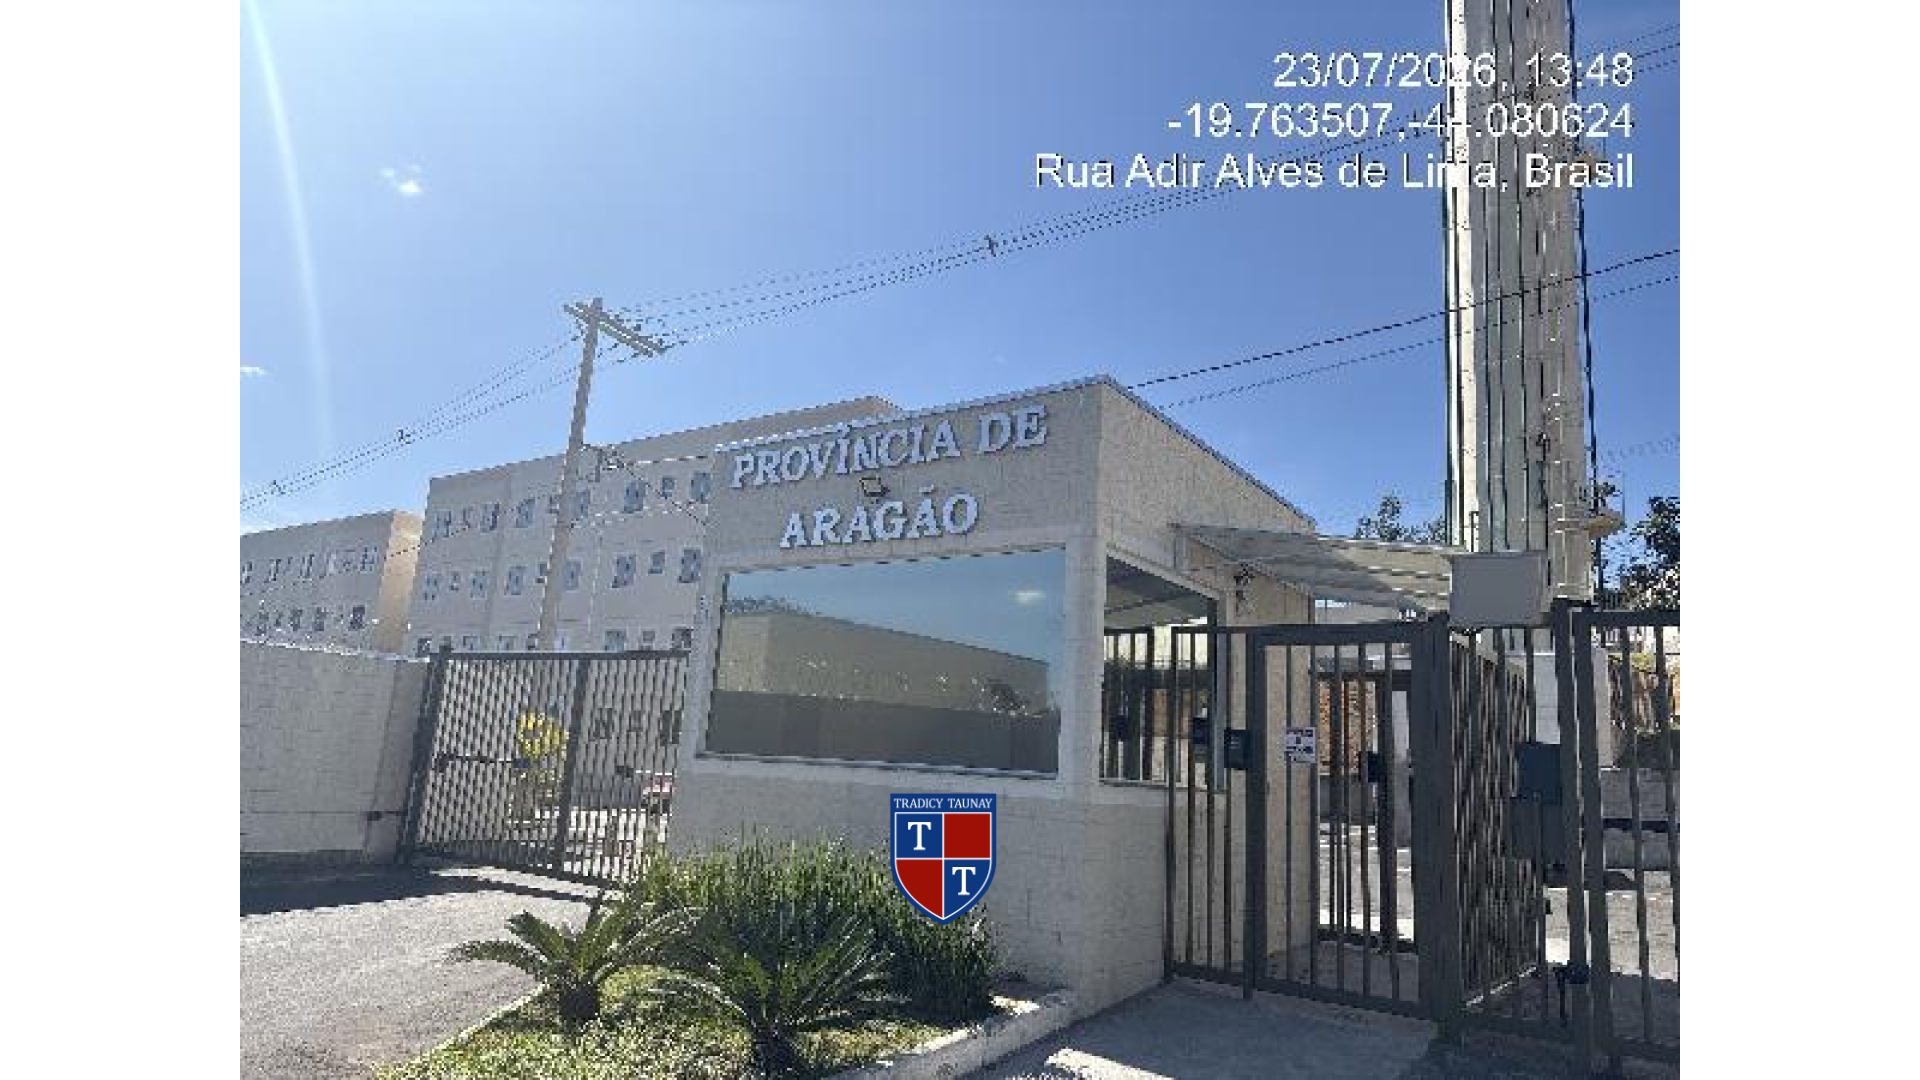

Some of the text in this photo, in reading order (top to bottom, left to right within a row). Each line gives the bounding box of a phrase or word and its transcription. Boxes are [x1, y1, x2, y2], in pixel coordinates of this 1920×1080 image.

[731, 405, 1047, 489] PROVÍNCIA DE
[779, 484, 979, 548] ARAGÃO
